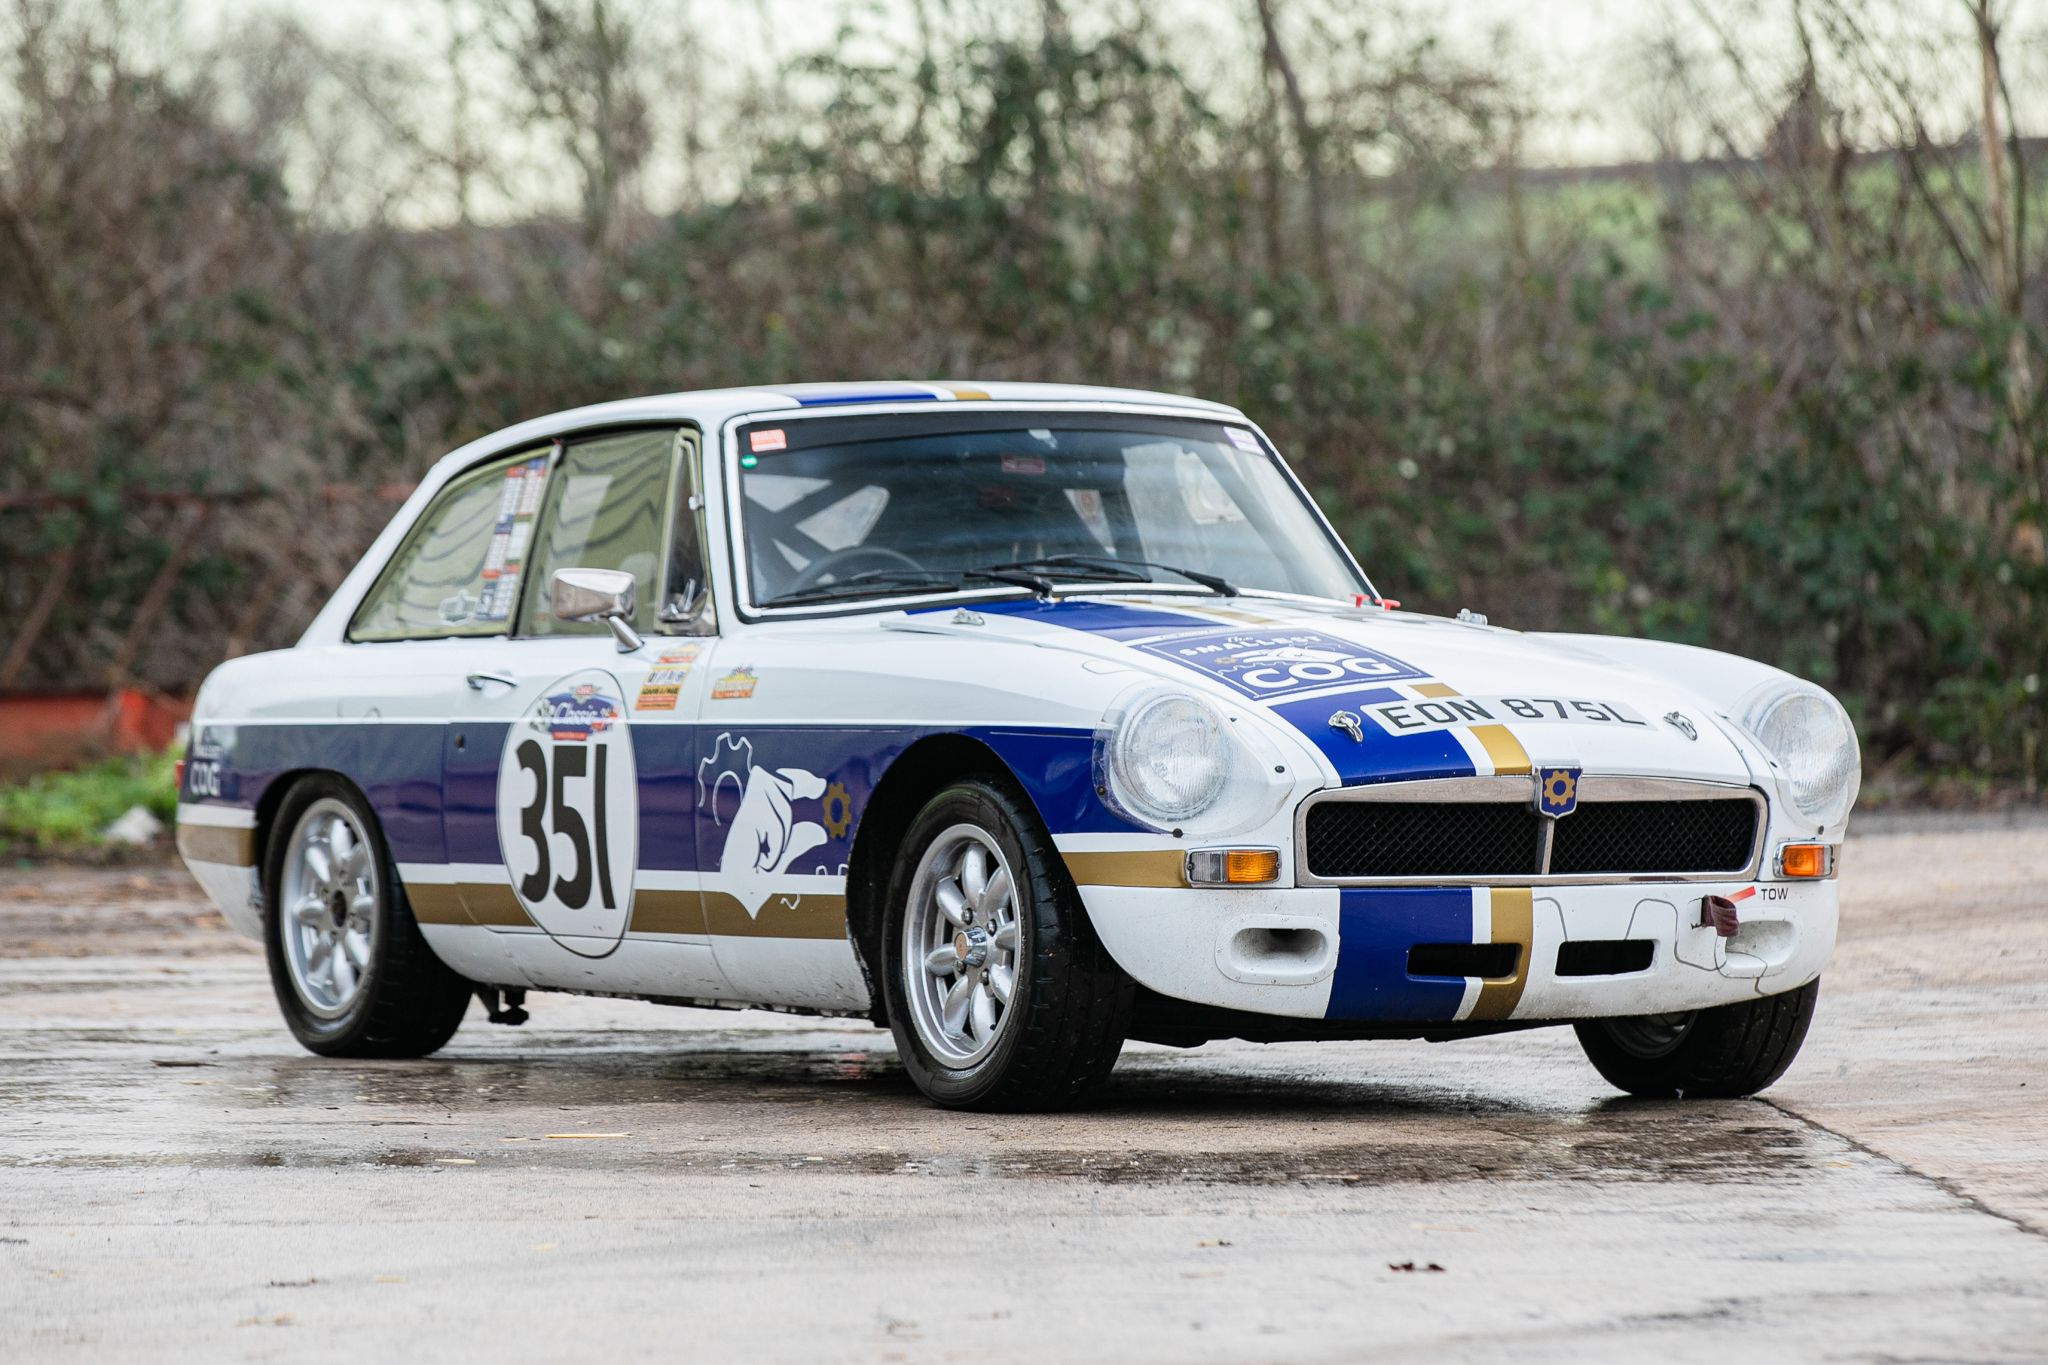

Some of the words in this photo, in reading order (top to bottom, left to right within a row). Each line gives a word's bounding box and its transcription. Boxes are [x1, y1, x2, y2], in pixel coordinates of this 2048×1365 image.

[1179, 635, 1322, 656] SMALLEST
[1241, 657, 1401, 689] COG
[552, 702, 599, 726] Classic
[1376, 699, 1496, 729] EON
[1500, 699, 1647, 726] 875L
[516, 739, 616, 910] 351
[1761, 887, 1789, 901] TOW
